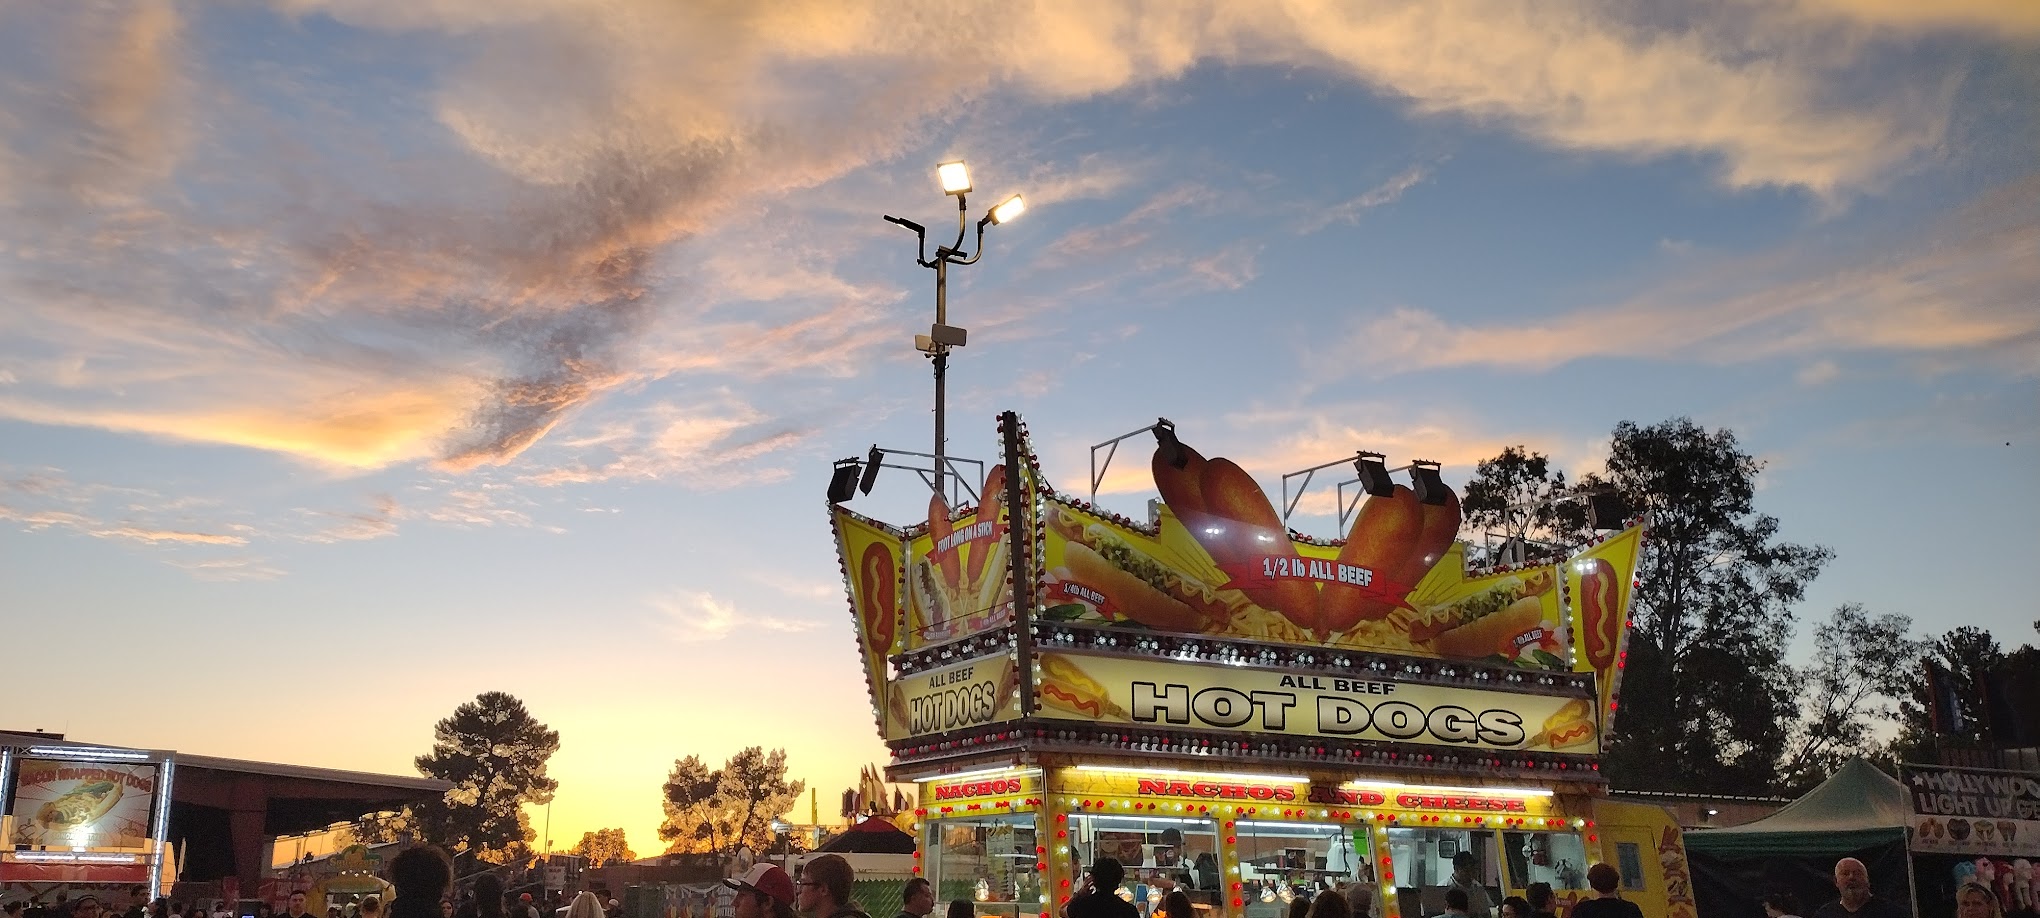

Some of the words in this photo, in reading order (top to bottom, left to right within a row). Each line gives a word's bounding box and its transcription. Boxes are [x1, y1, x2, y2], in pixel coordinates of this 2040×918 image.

[938, 540, 950, 554] FOOT
[951, 531, 964, 547] LONG
[965, 527, 973, 541] ON
[977, 521, 993, 537] STICK
[1263, 557, 1289, 580] 1/2
[1309, 560, 1335, 581] ALL
[1337, 563, 1373, 587] BEEF
[1080, 587, 1090, 599] ALL
[1091, 591, 1105, 604] BEEF
[929, 674, 946, 690] ALL
[948, 667, 974, 685] BEEF
[1279, 675, 1327, 692] ALL
[1333, 679, 1396, 696] BEEF
[910, 692, 943, 735] HOT
[944, 680, 996, 729] DOGS
[1131, 681, 1297, 731] HOT
[1316, 696, 1526, 746] DOGS
[57, 768, 105, 781] WRAPPED
[106, 769, 127, 784] HOT
[127, 773, 153, 793] DOGS
[935, 777, 1021, 800] NACHOS
[1138, 778, 1295, 801] NACHOS
[1308, 785, 1386, 806] AND
[1396, 792, 1527, 812] CHEESE
[1918, 793, 1980, 815] LIGHT
[1984, 796, 2012, 818] UP
